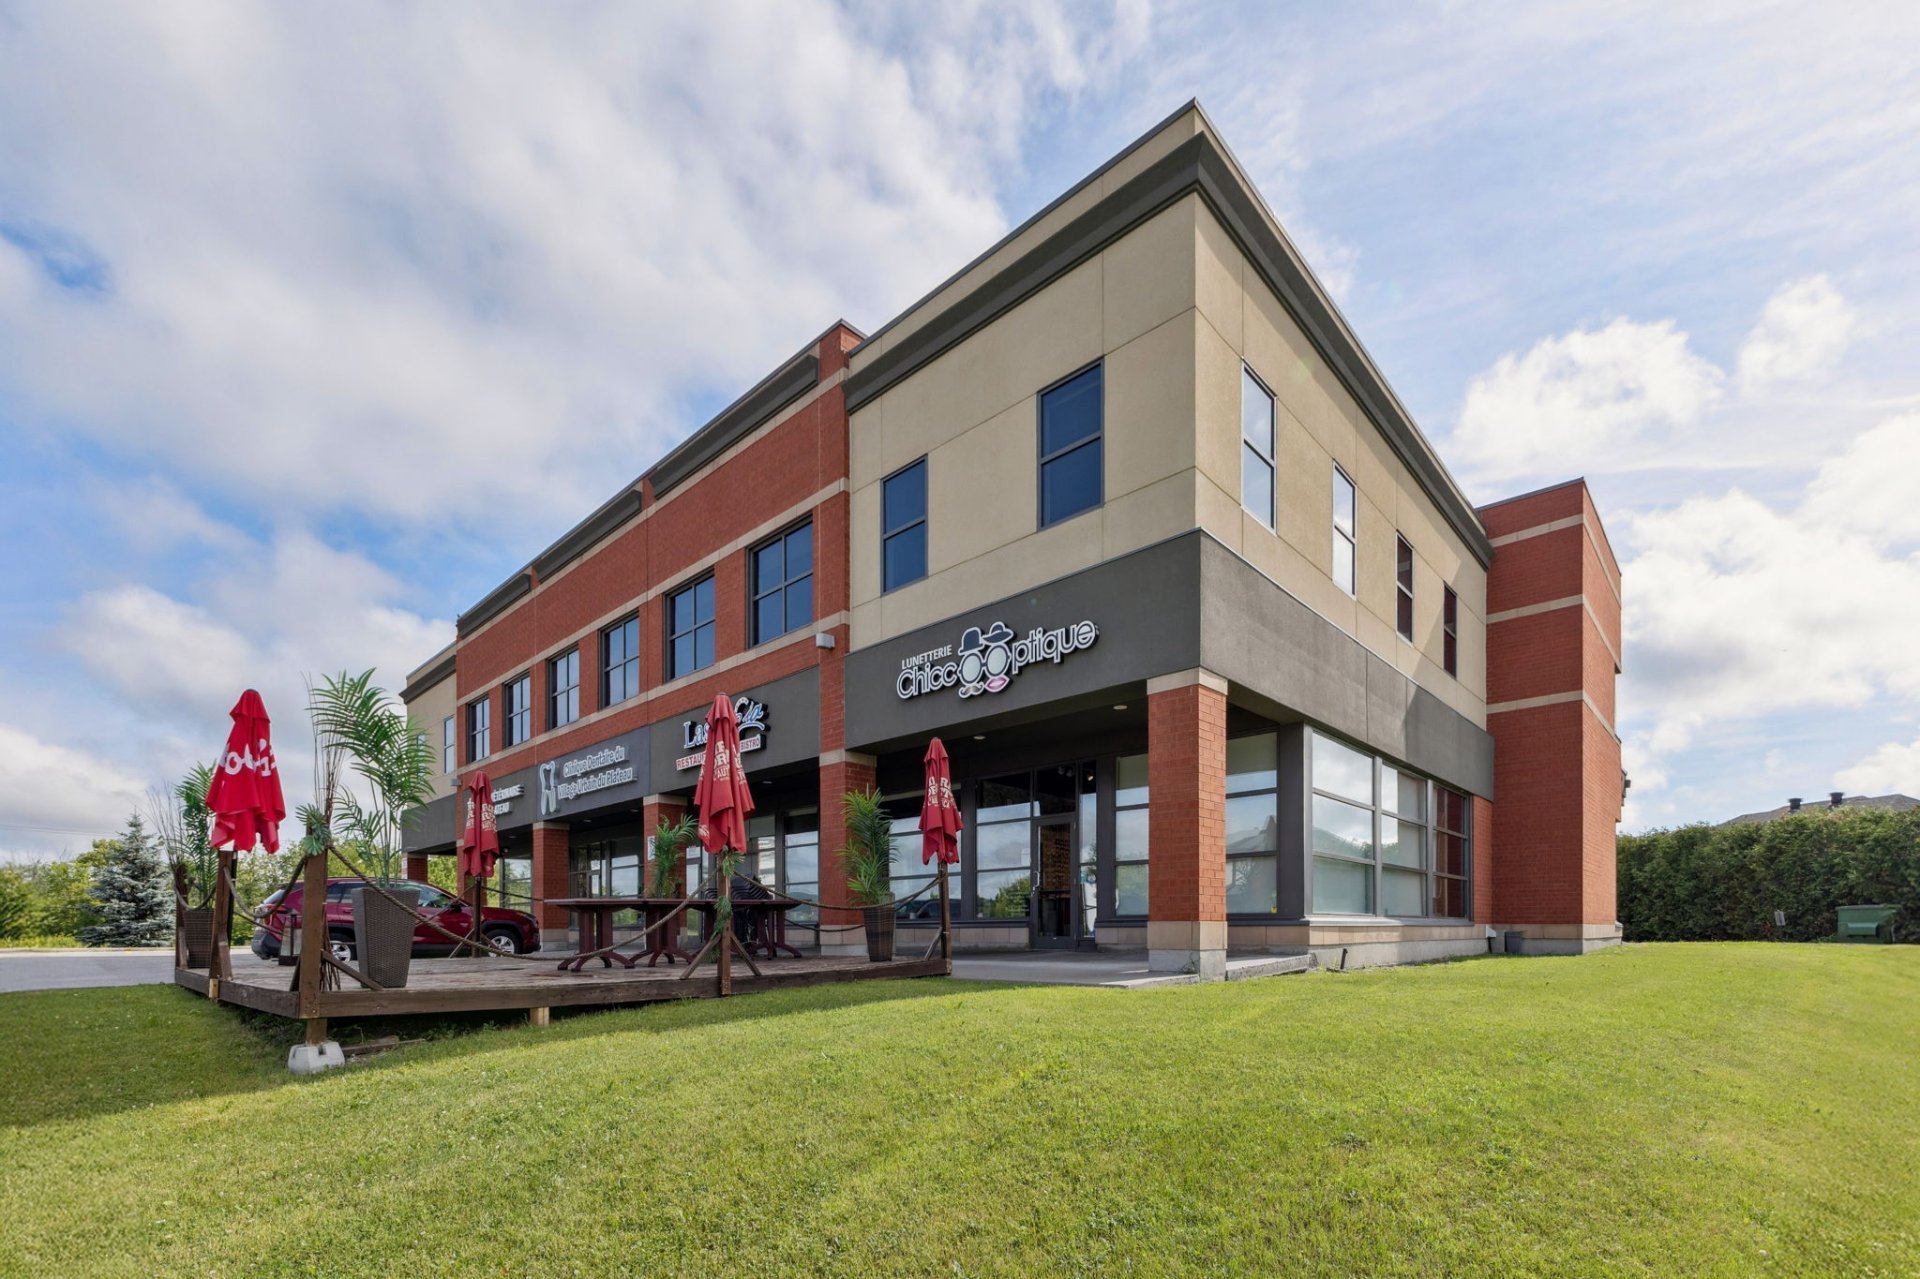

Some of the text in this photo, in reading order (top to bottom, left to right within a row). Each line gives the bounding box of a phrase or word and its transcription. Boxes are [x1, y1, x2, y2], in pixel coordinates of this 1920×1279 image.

[902, 644, 952, 670] LUNETTERIE
[740, 735, 761, 752] BISTRO
[563, 745, 625, 777] Clinique Dentaire du
[558, 767, 633, 800] Village Urbain du Plateau
